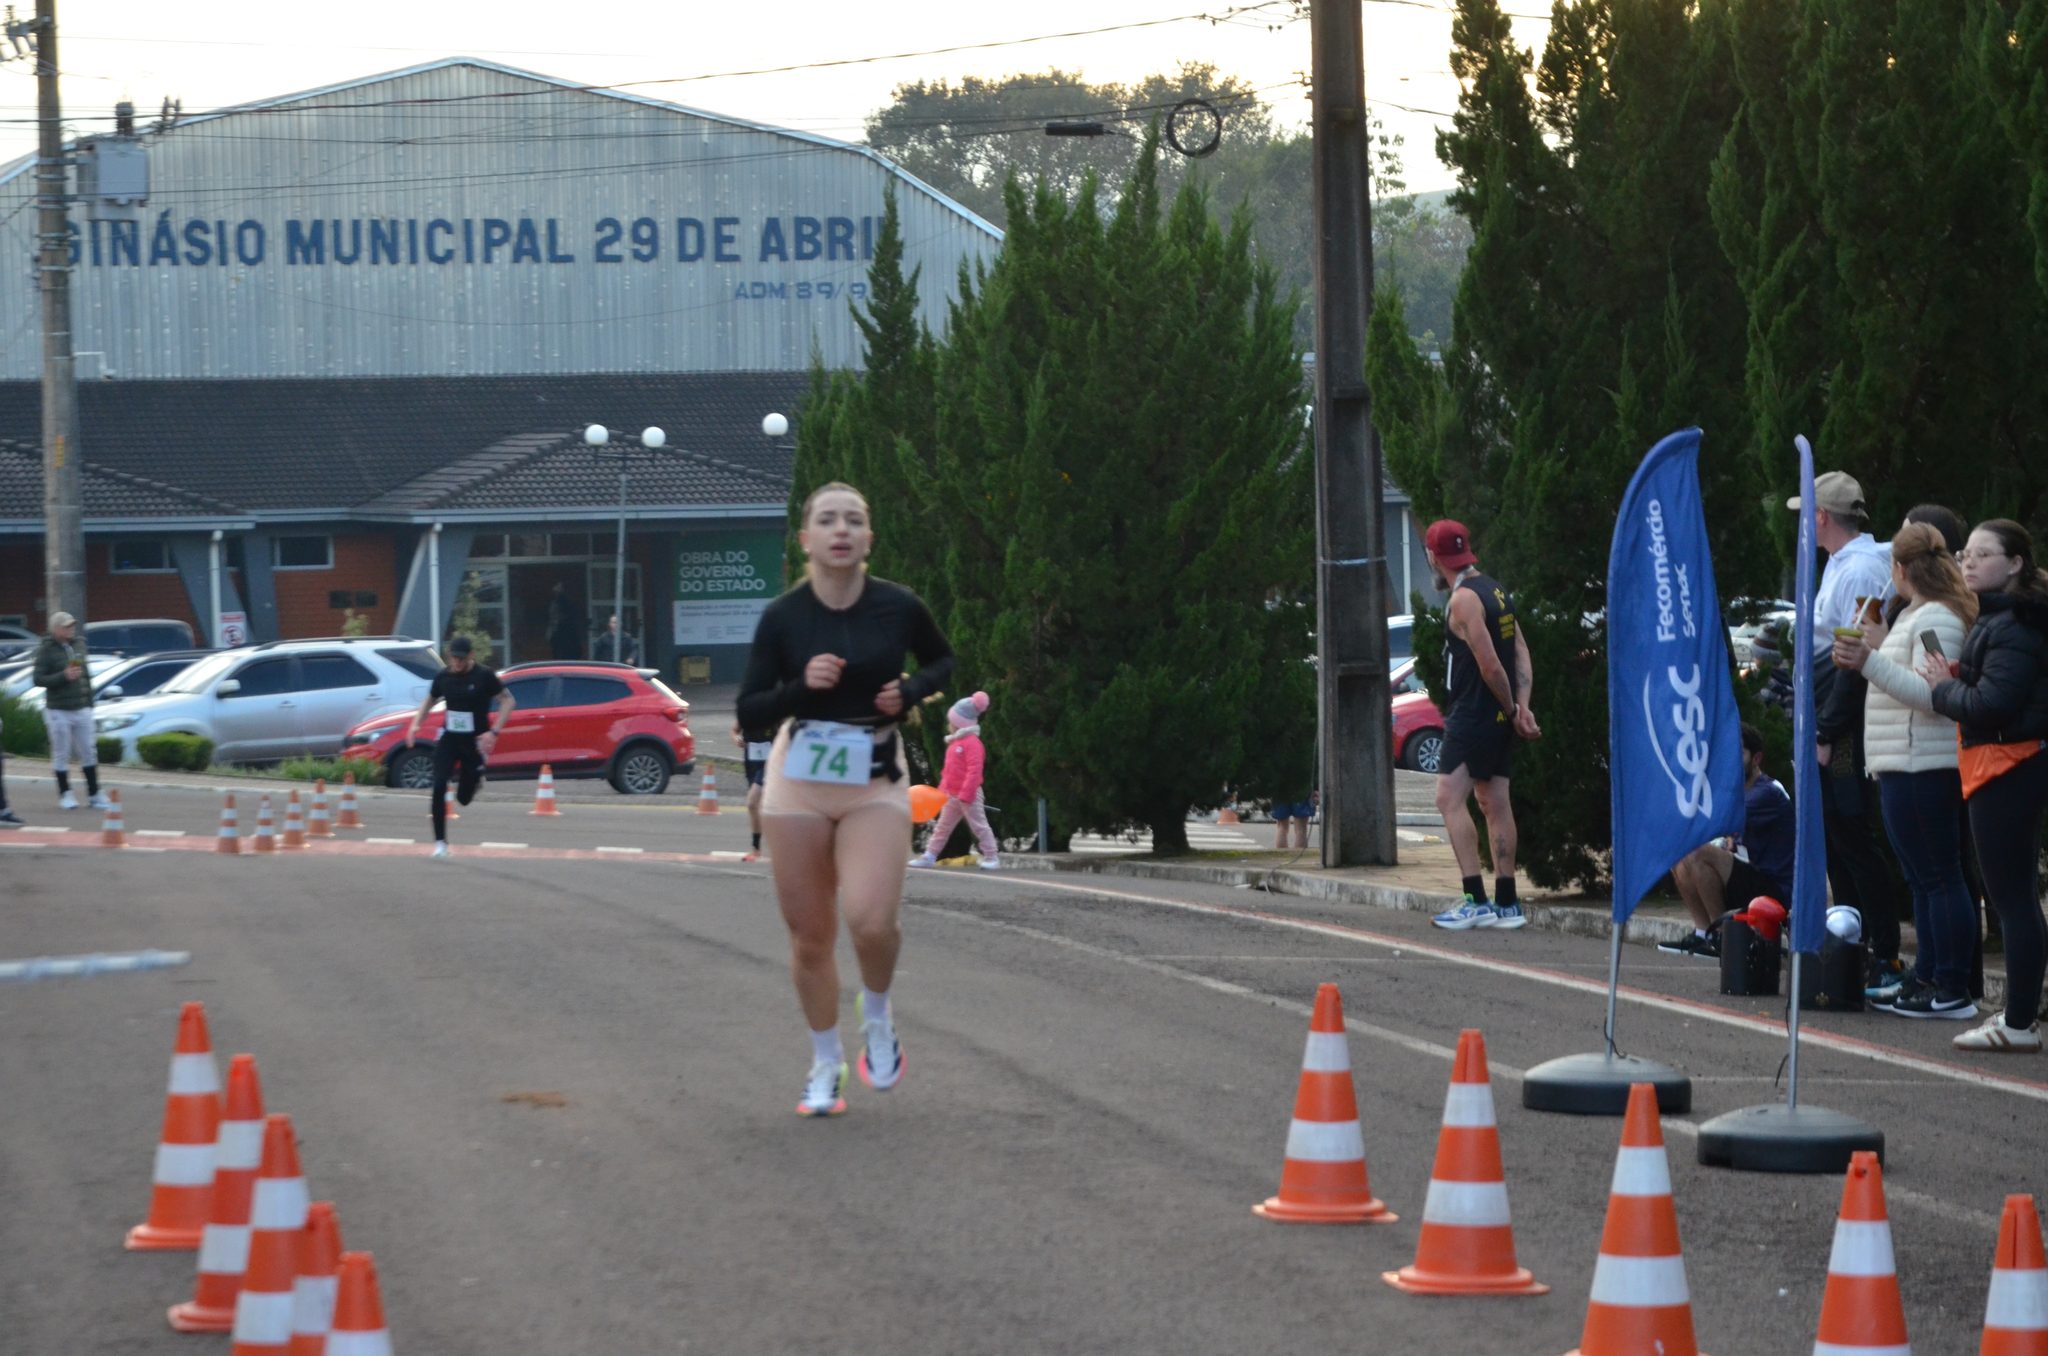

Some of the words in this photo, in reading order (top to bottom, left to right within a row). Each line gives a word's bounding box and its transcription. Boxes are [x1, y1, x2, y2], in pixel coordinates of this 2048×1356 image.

[286, 217, 575, 266] MUNICIPAL
[594, 216, 660, 264] 29
[677, 216, 741, 263] DE
[735, 281, 786, 300] ADM
[679, 551, 724, 565] OBRA
[725, 550, 749, 563] DO
[679, 564, 755, 578] GOVERNO
[1644, 498, 1677, 644] Fecomércio
[679, 580, 704, 592] DO
[707, 578, 767, 591] ESTADO
[808, 743, 849, 778] 74
